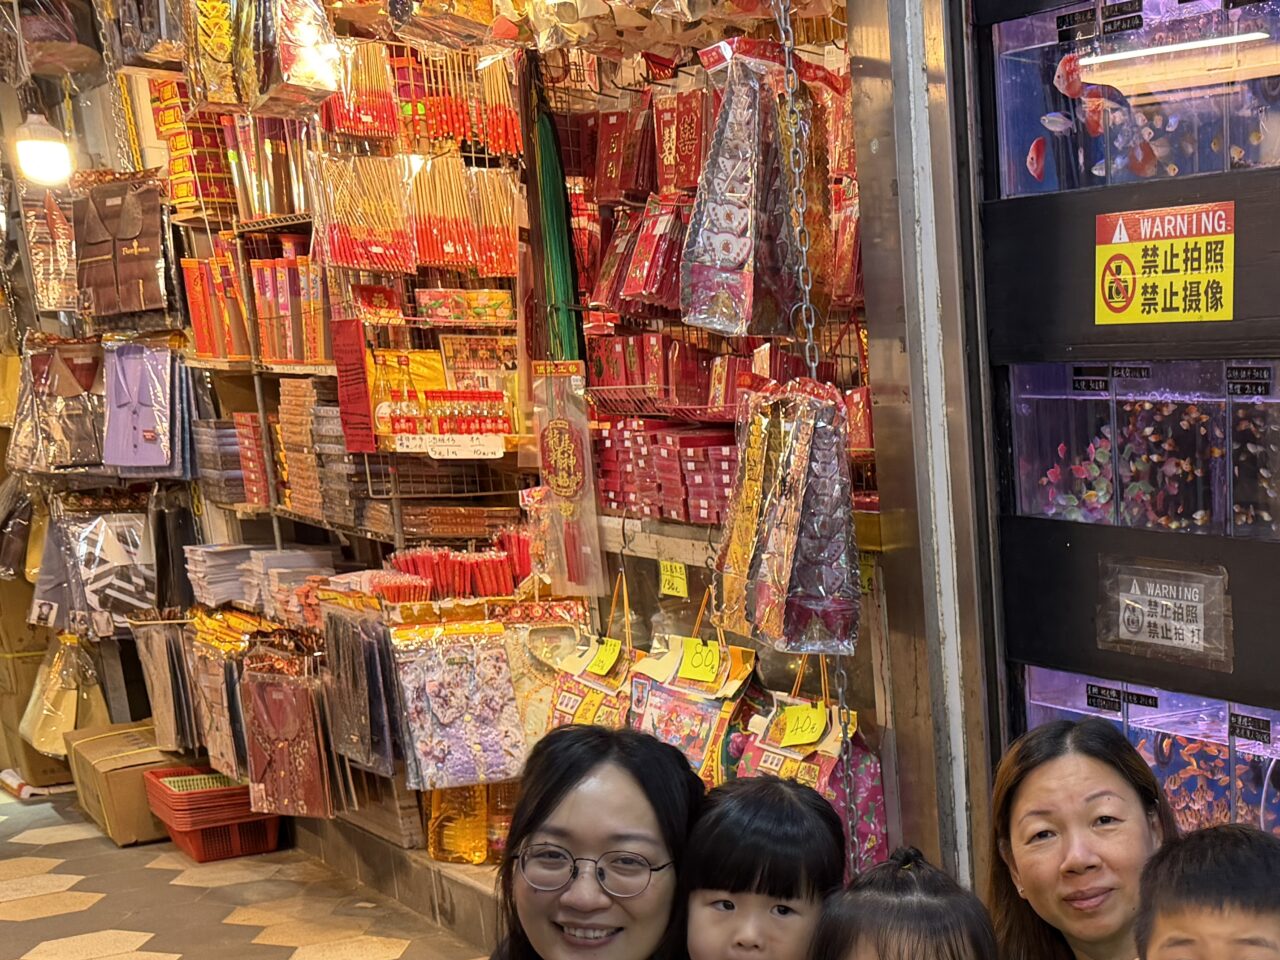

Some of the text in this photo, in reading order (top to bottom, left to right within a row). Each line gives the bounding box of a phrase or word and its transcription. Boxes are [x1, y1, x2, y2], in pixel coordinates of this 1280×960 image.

[1140, 211, 1226, 238] WARNING
[1141, 240, 1225, 277] 禁止拍照
[1141, 280, 1224, 315] 禁止摄像
[1147, 582, 1200, 602] WARNING
[1147, 600, 1199, 624] 禁止拍照
